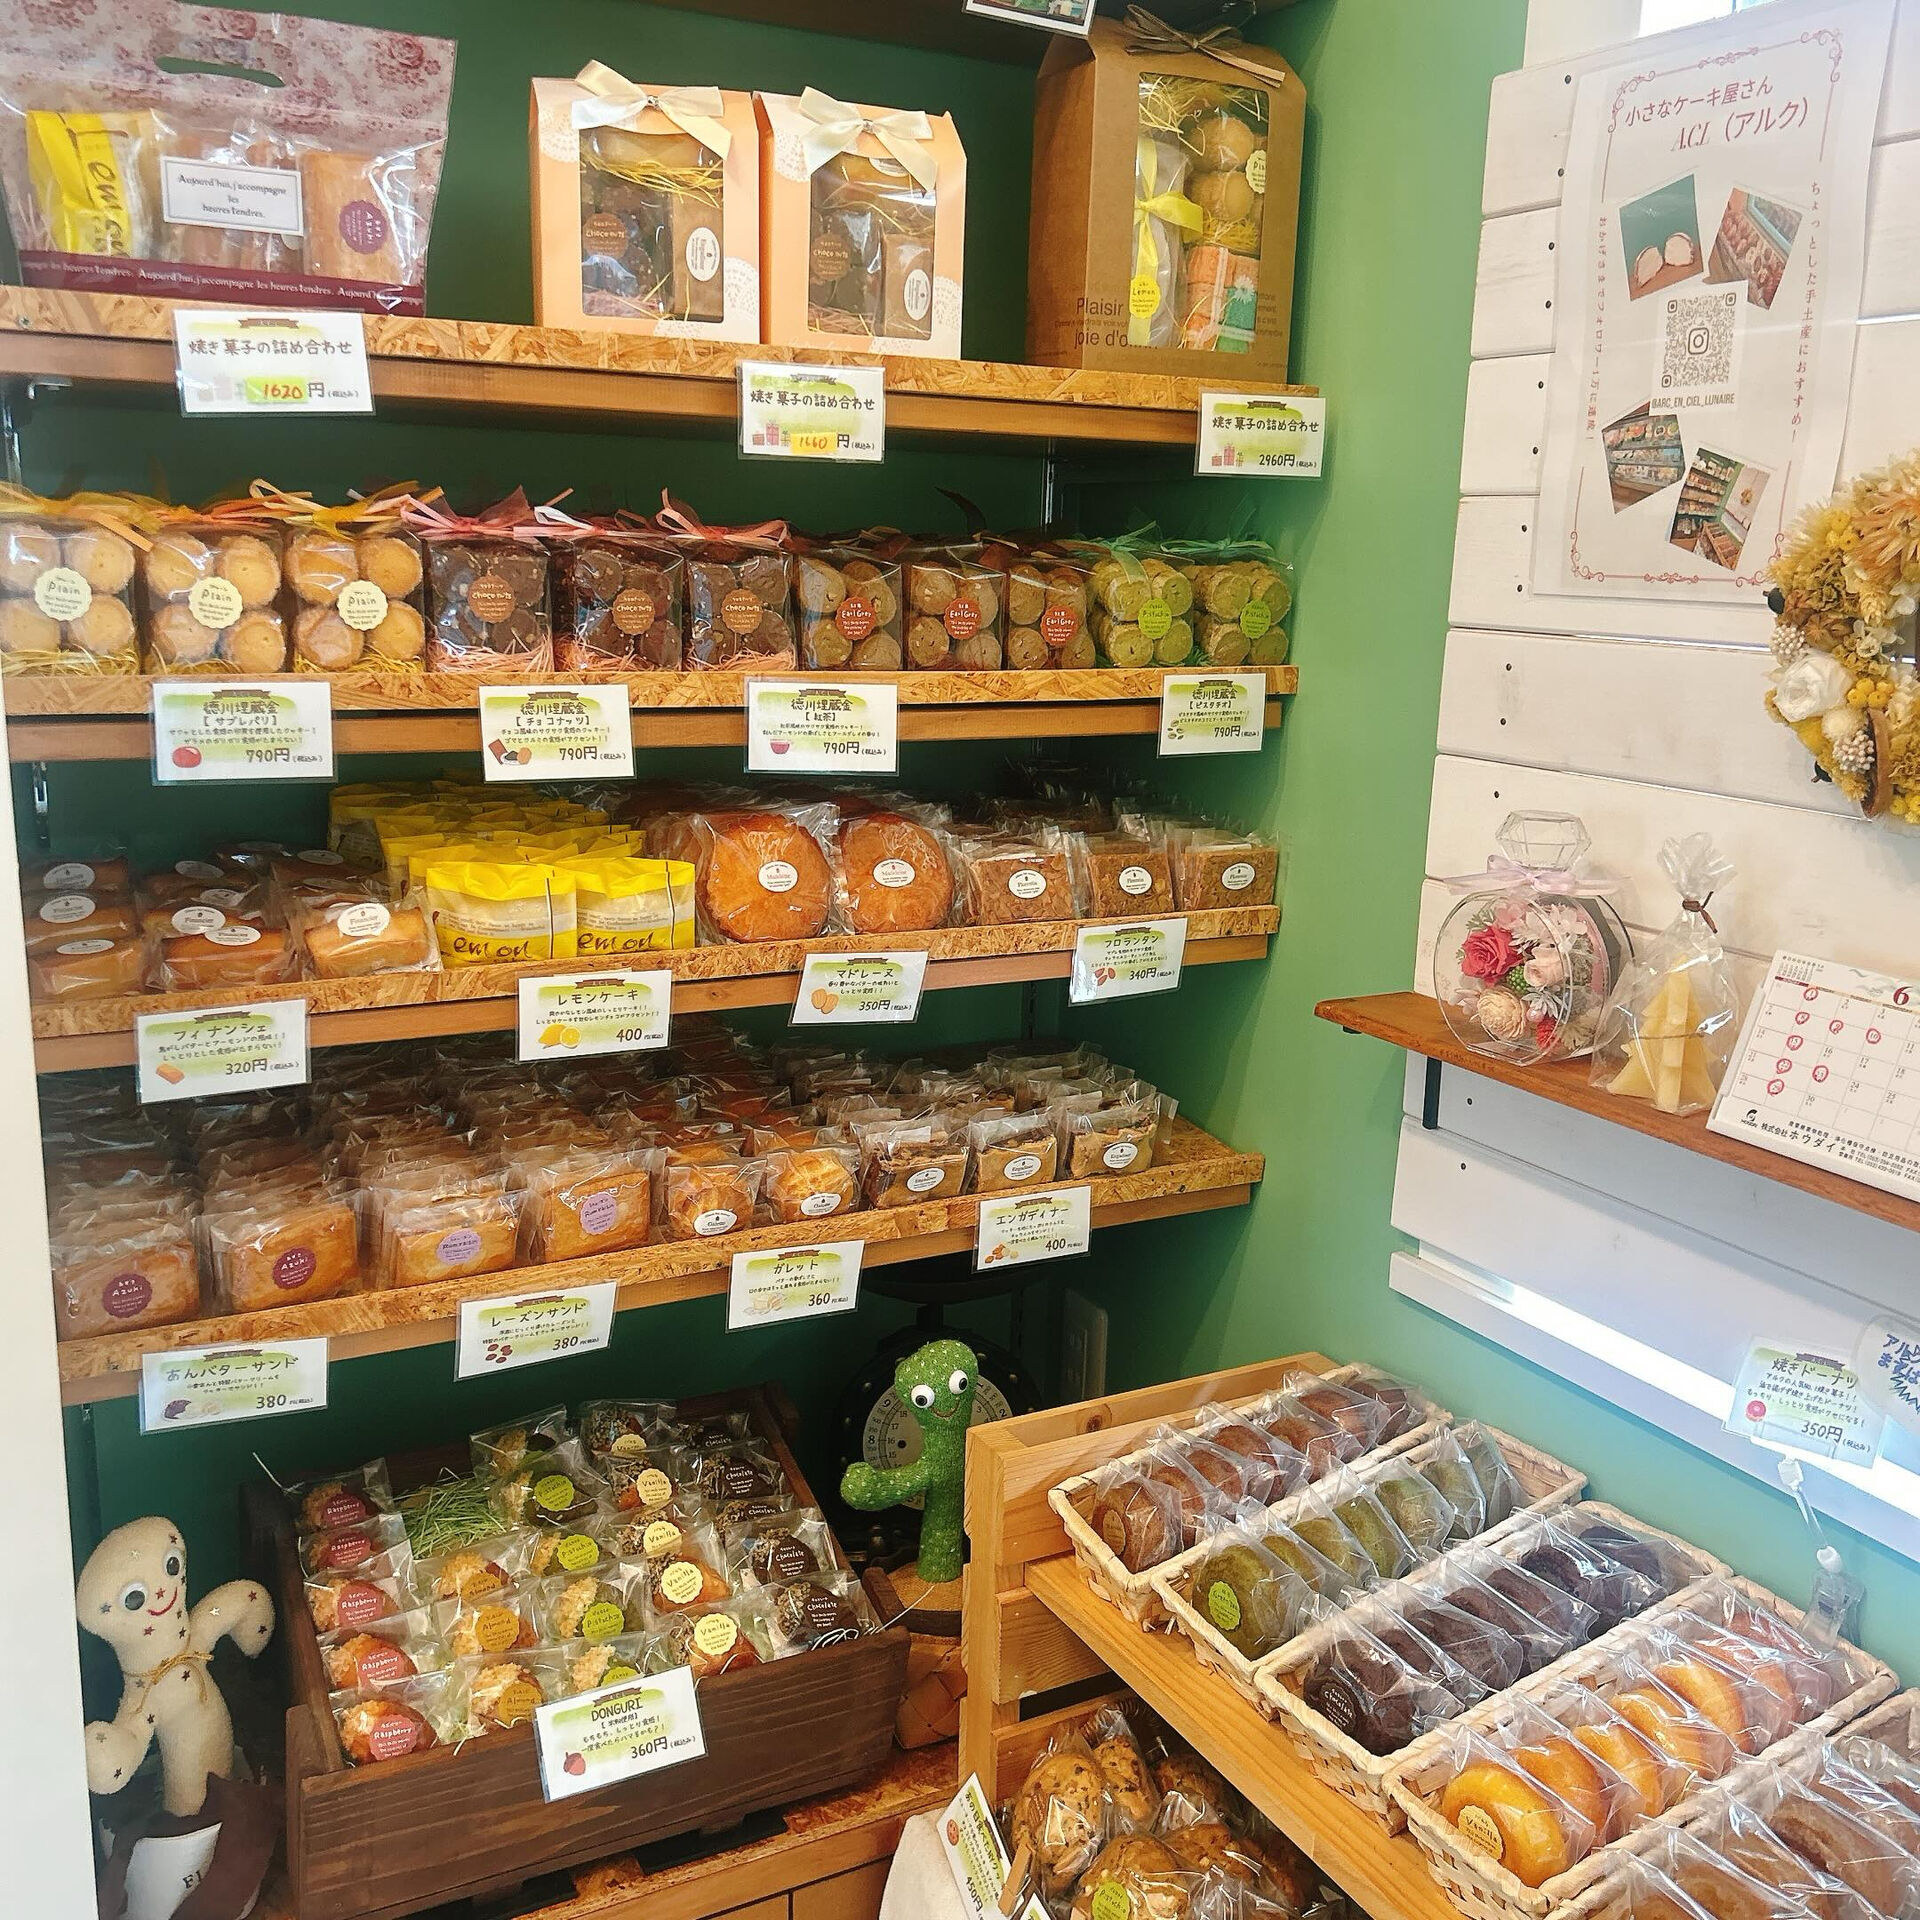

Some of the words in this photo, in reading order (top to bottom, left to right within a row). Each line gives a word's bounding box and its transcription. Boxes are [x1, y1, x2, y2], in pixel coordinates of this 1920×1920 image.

[1625, 75, 1774, 126] 小さなケーキ屋さん
[1076, 298, 1124, 316] Plaisir
[1074, 328, 1100, 349] joie
[188, 340, 353, 356] 焼き菓子の詰め合わせ
[750, 390, 876, 411] 焼き菓子の詰め合わせ
[1212, 416, 1320, 433] 焼き菓子の詰め合わせ
[48, 580, 82, 596] Plain
[201, 587, 234, 604] Plain
[348, 595, 378, 608] Plain
[203, 701, 280, 716] 徳川埋蔵金
[520, 701, 588, 716] 徳川埋蔵金
[791, 698, 854, 712] 徳川埋蔵金
[559, 746, 598, 761] 790円
[823, 741, 860, 755] 790円
[1105, 935, 1159, 948] フロランタン
[837, 968, 894, 979] マドレーヌ
[1129, 967, 1157, 981] 340円
[557, 989, 639, 1006] レモンケーキ
[1893, 986, 1913, 1006] 6
[858, 1000, 891, 1012] 350円
[174, 1022, 267, 1042] フィナンシェ
[616, 1028, 643, 1043] 400
[225, 1058, 268, 1075] 320円
[996, 1206, 1069, 1225] エンガディナー
[1045, 1238, 1067, 1252] 400
[773, 1259, 819, 1275] ガレット
[808, 1292, 831, 1307] 360
[491, 1302, 587, 1328] レーズンサンド
[552, 1336, 579, 1351] 380
[166, 1356, 299, 1382] あんバターサンド
[1771, 1358, 1859, 1389] 焼きドーナツ
[256, 1394, 287, 1409] 380
[1000, 1408, 1008, 1417] 2
[868, 1435, 875, 1445] 8
[341, 1596, 379, 1610] Raspberry
[807, 1601, 838, 1612] Chocolate
[700, 1622, 731, 1637] Vanilla
[361, 1656, 400, 1672] Raspberry
[591, 1696, 644, 1722] DONGURI
[373, 1727, 412, 1741] Raspberry
[631, 1736, 668, 1759] 360円
